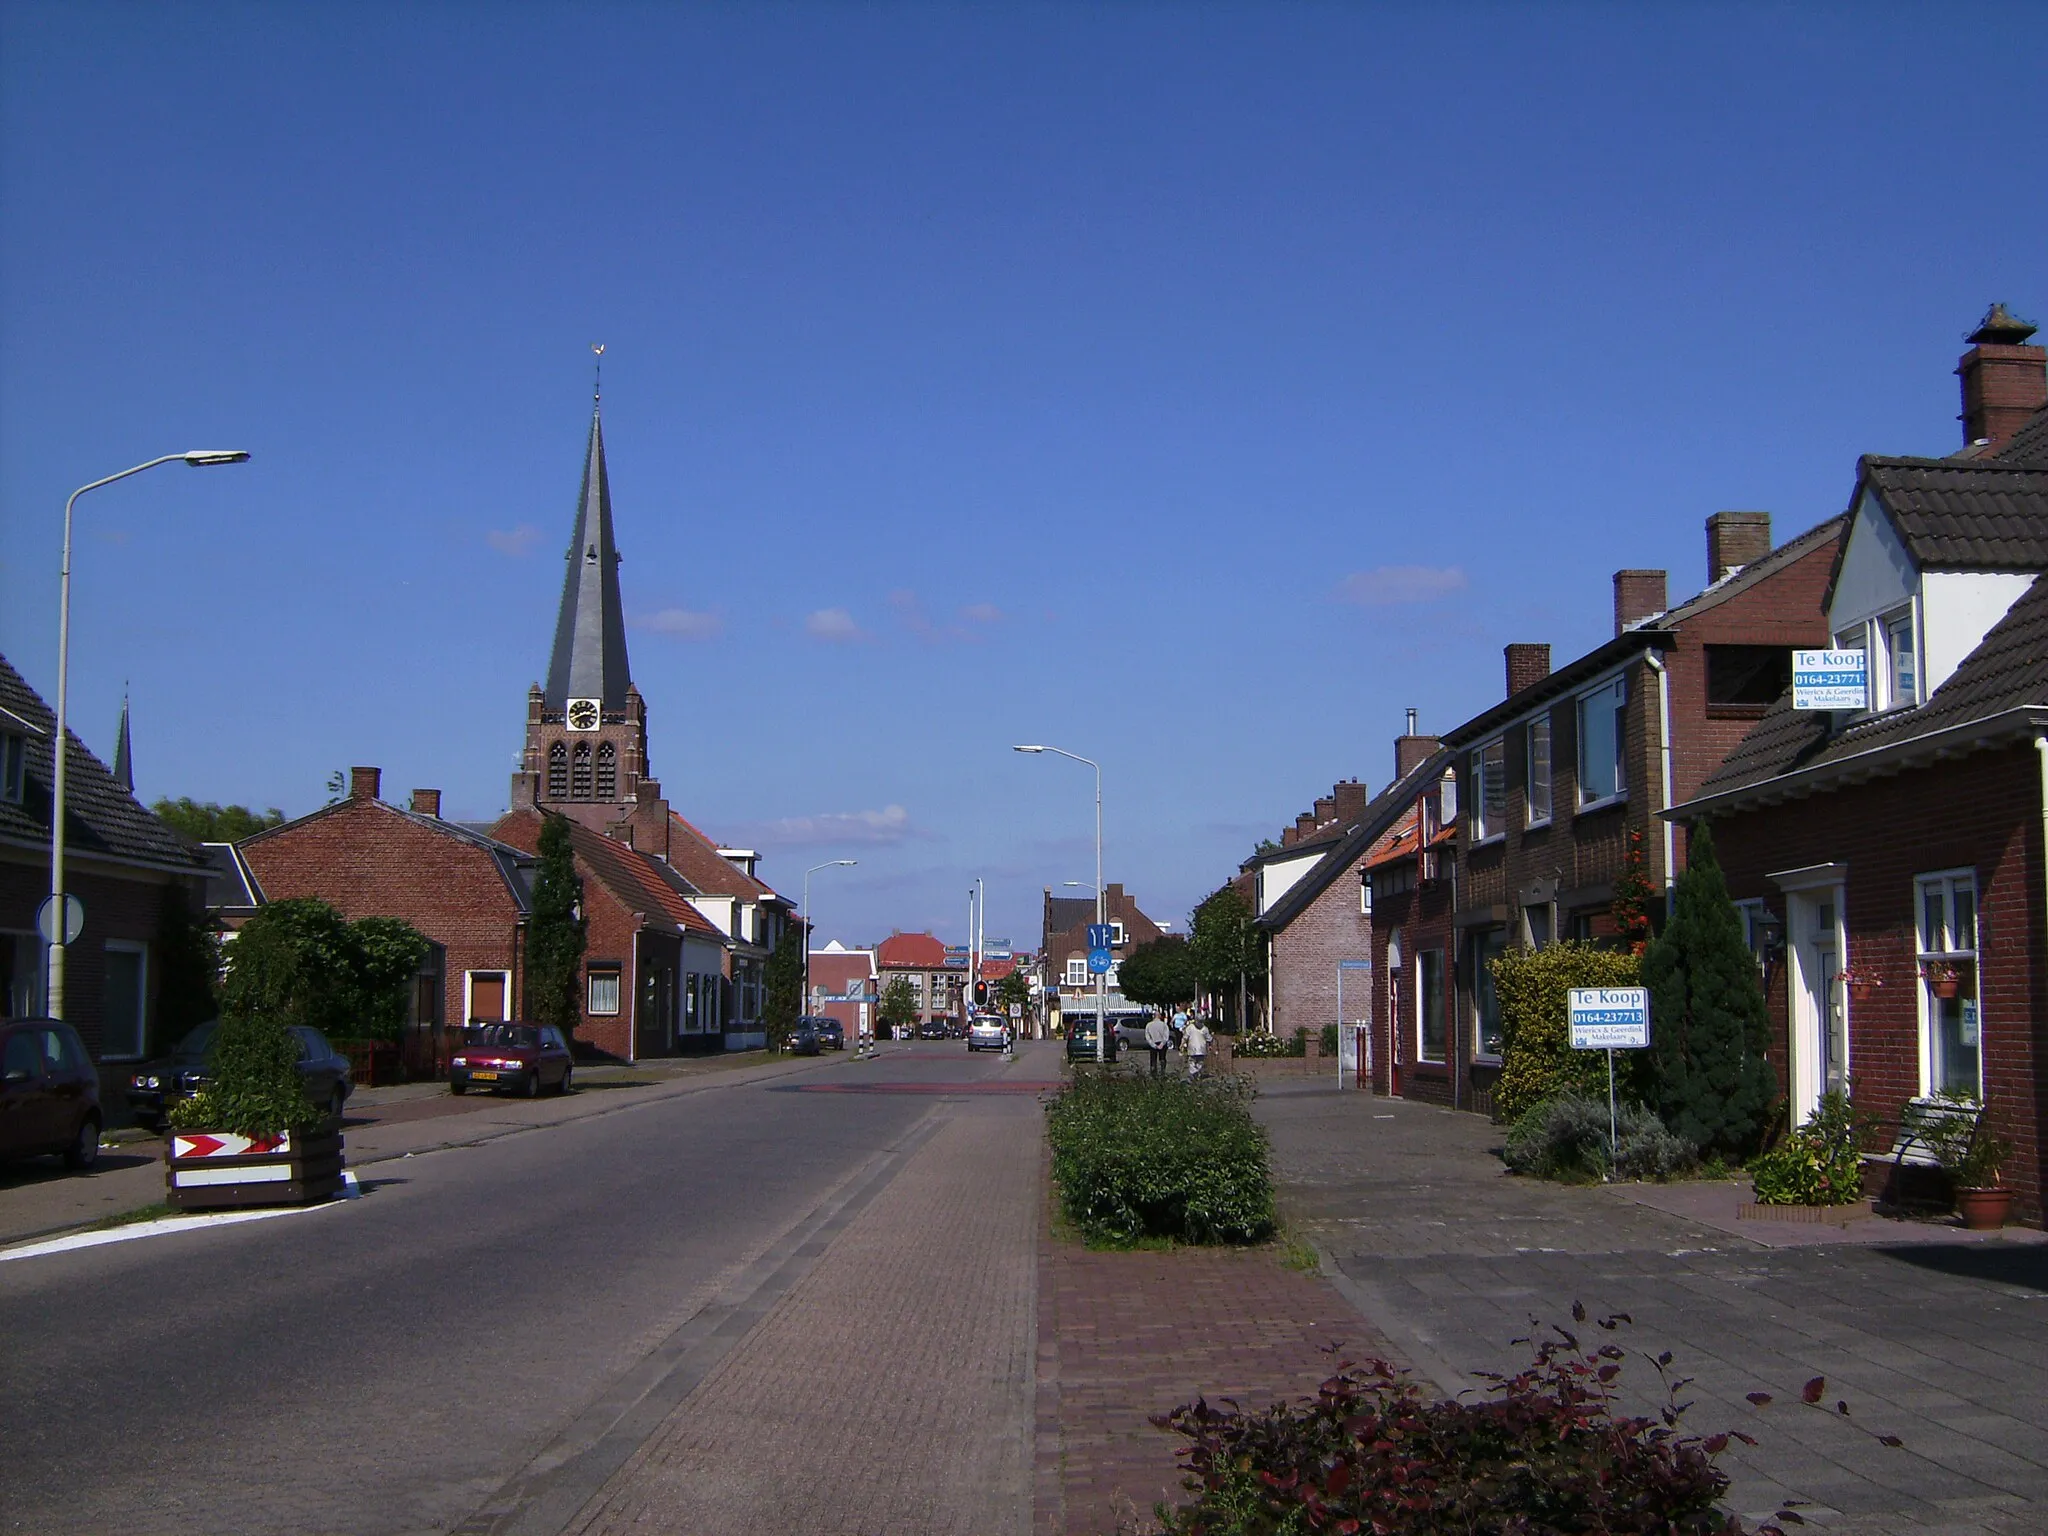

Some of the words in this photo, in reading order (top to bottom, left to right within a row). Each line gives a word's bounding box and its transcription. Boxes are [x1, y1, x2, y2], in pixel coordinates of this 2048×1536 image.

[1797, 652, 1815, 666] Te
[1822, 651, 1866, 669] Koop
[1575, 990, 1593, 1004] Te
[1599, 989, 1641, 1007] Koop
[1574, 1012, 1643, 1023] 0164-237713
